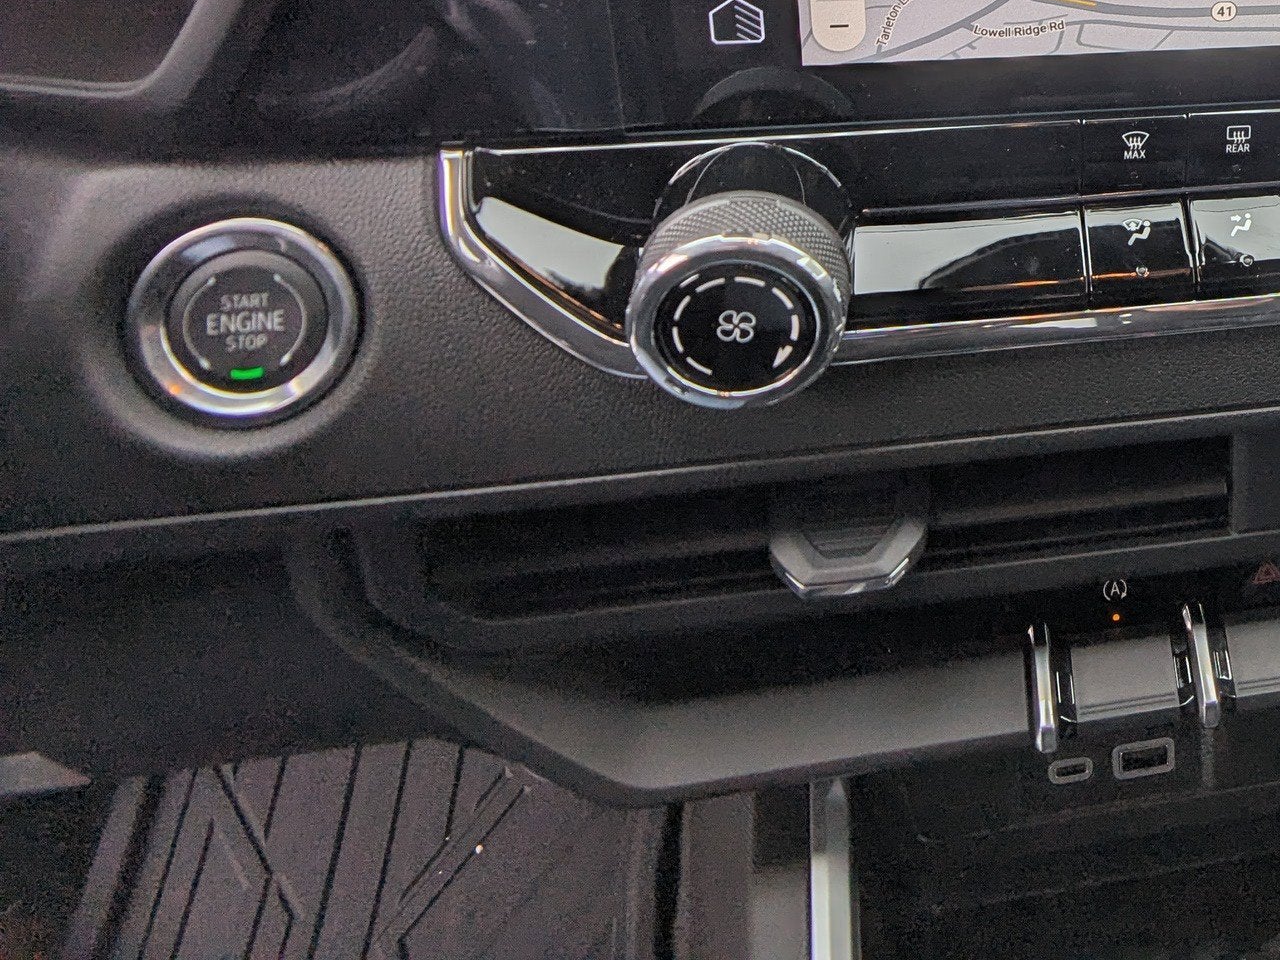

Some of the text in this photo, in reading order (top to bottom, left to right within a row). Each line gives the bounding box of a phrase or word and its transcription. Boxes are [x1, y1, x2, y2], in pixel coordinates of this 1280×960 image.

[1216, 5, 1233, 17] 41
[875, 3, 902, 47] Tarleton
[973, 19, 1066, 38] Lowell Ridge Rd
[1123, 149, 1147, 160] MAX
[1225, 143, 1251, 153] REAR
[220, 292, 269, 310] START
[206, 308, 285, 336] ENGINE
[225, 336, 268, 352] STOP
